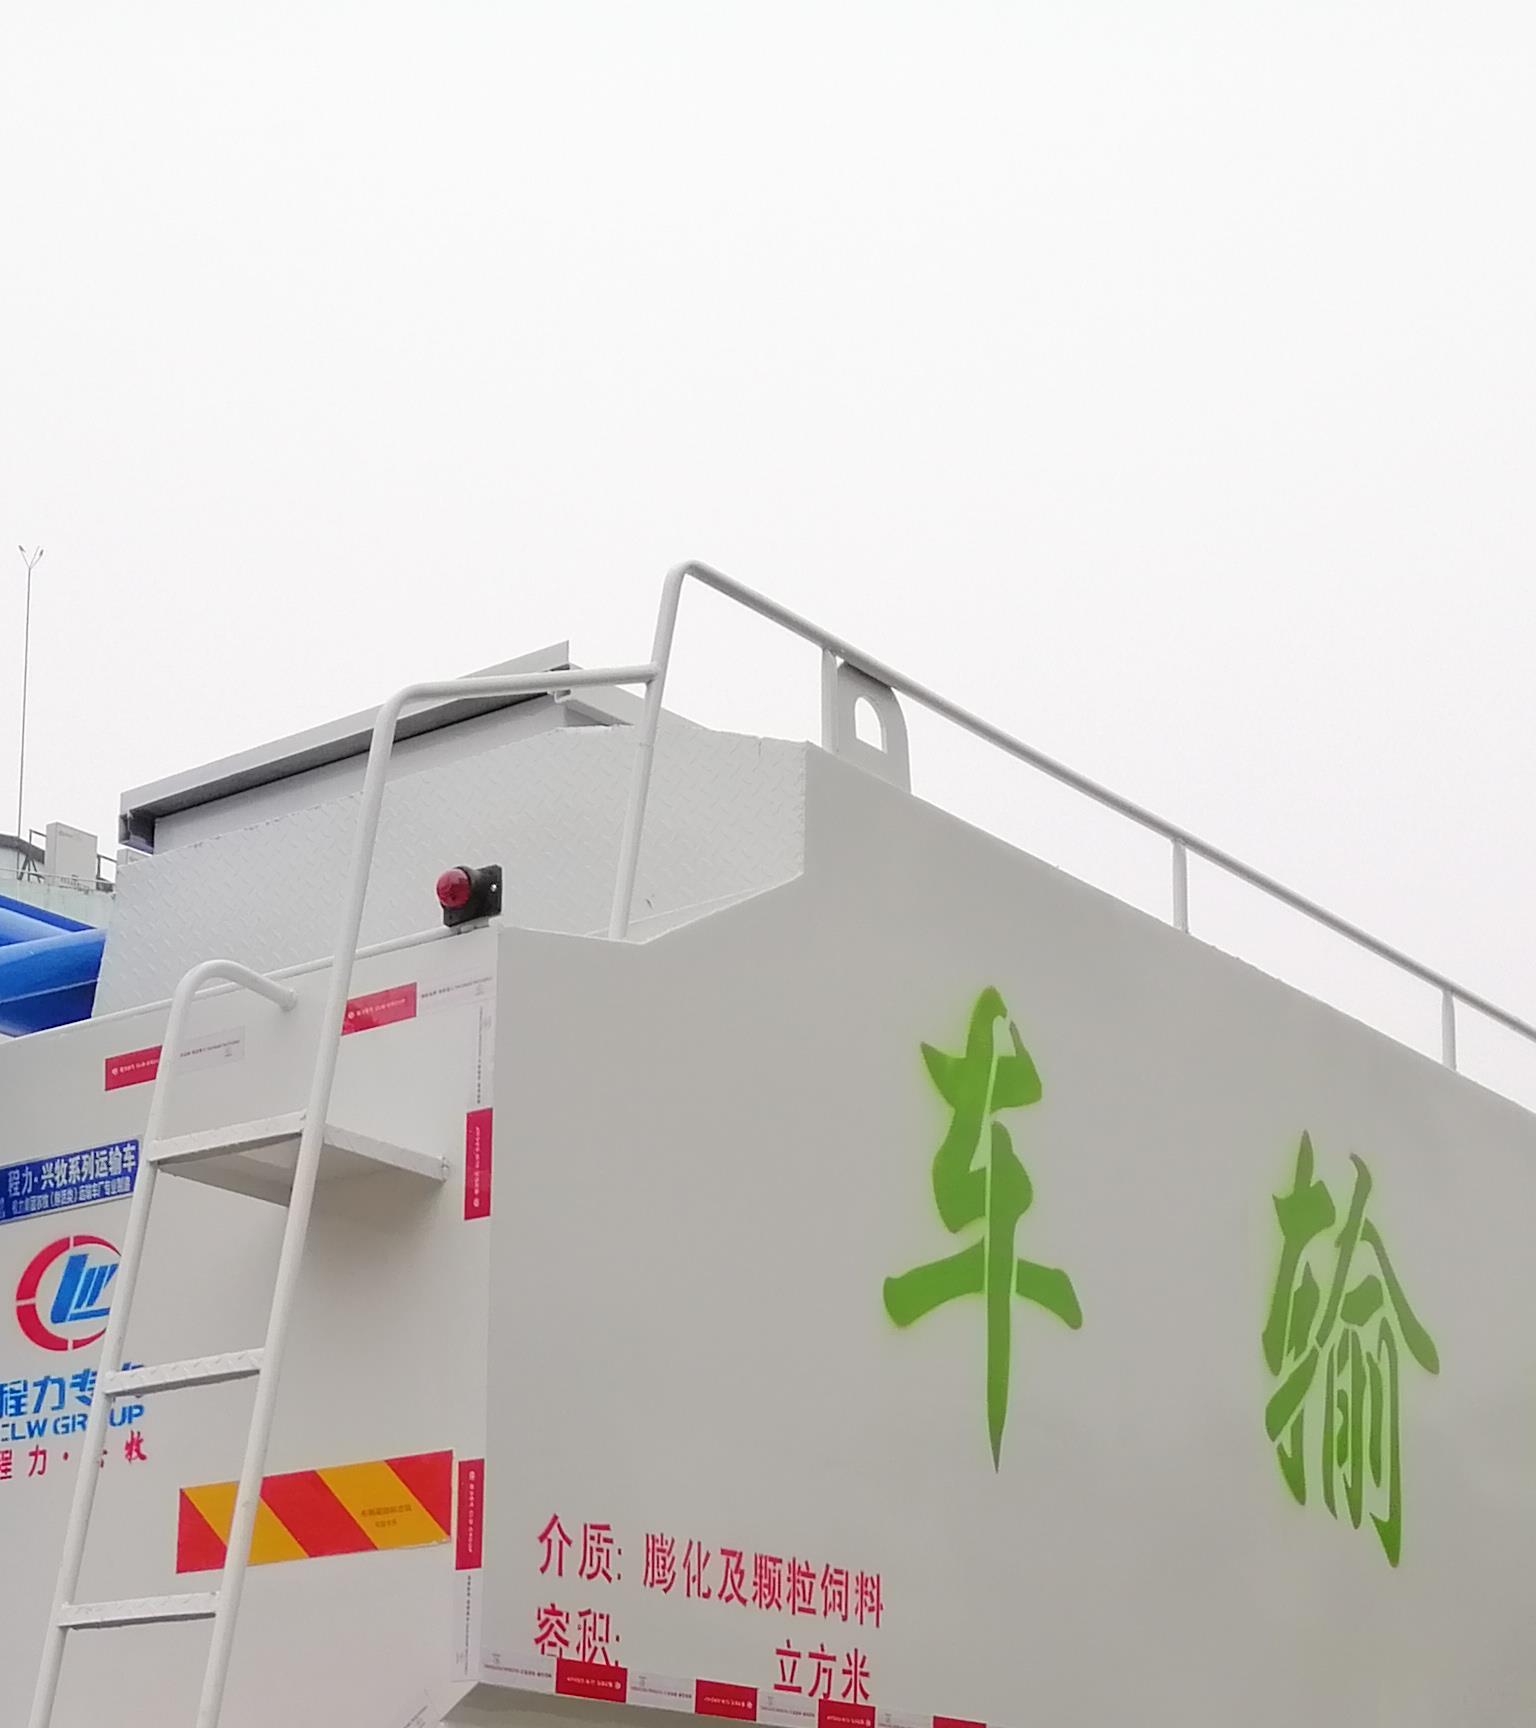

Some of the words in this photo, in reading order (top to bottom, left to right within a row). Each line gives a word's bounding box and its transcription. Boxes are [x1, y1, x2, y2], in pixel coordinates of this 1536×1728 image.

[53, 1404, 145, 1435] GRUP
[643, 1532, 884, 1628] 膨化及颗粒饲料
[774, 1639, 871, 1702] 立方米
